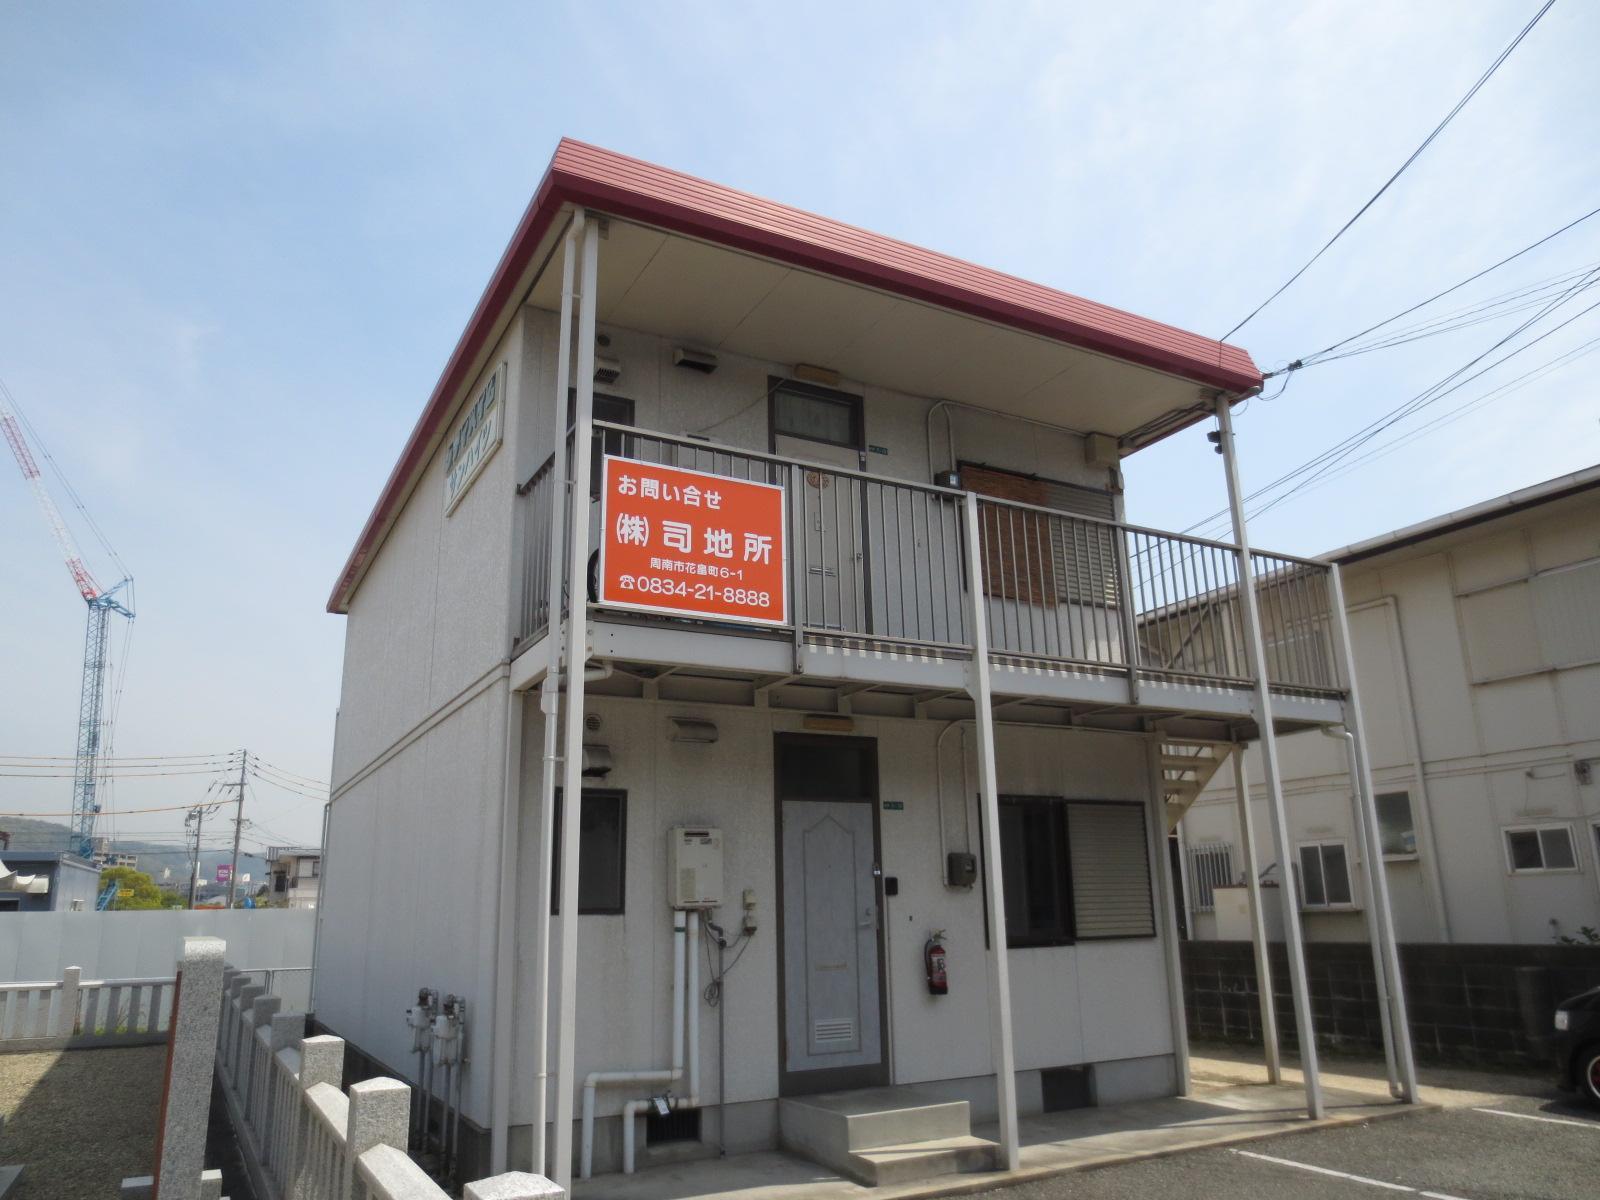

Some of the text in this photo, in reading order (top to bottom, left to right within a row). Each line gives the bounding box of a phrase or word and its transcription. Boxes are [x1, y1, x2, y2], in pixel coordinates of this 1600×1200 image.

[618, 474, 722, 510] お問い合せ
[637, 576, 770, 607] 0834-21-8888
